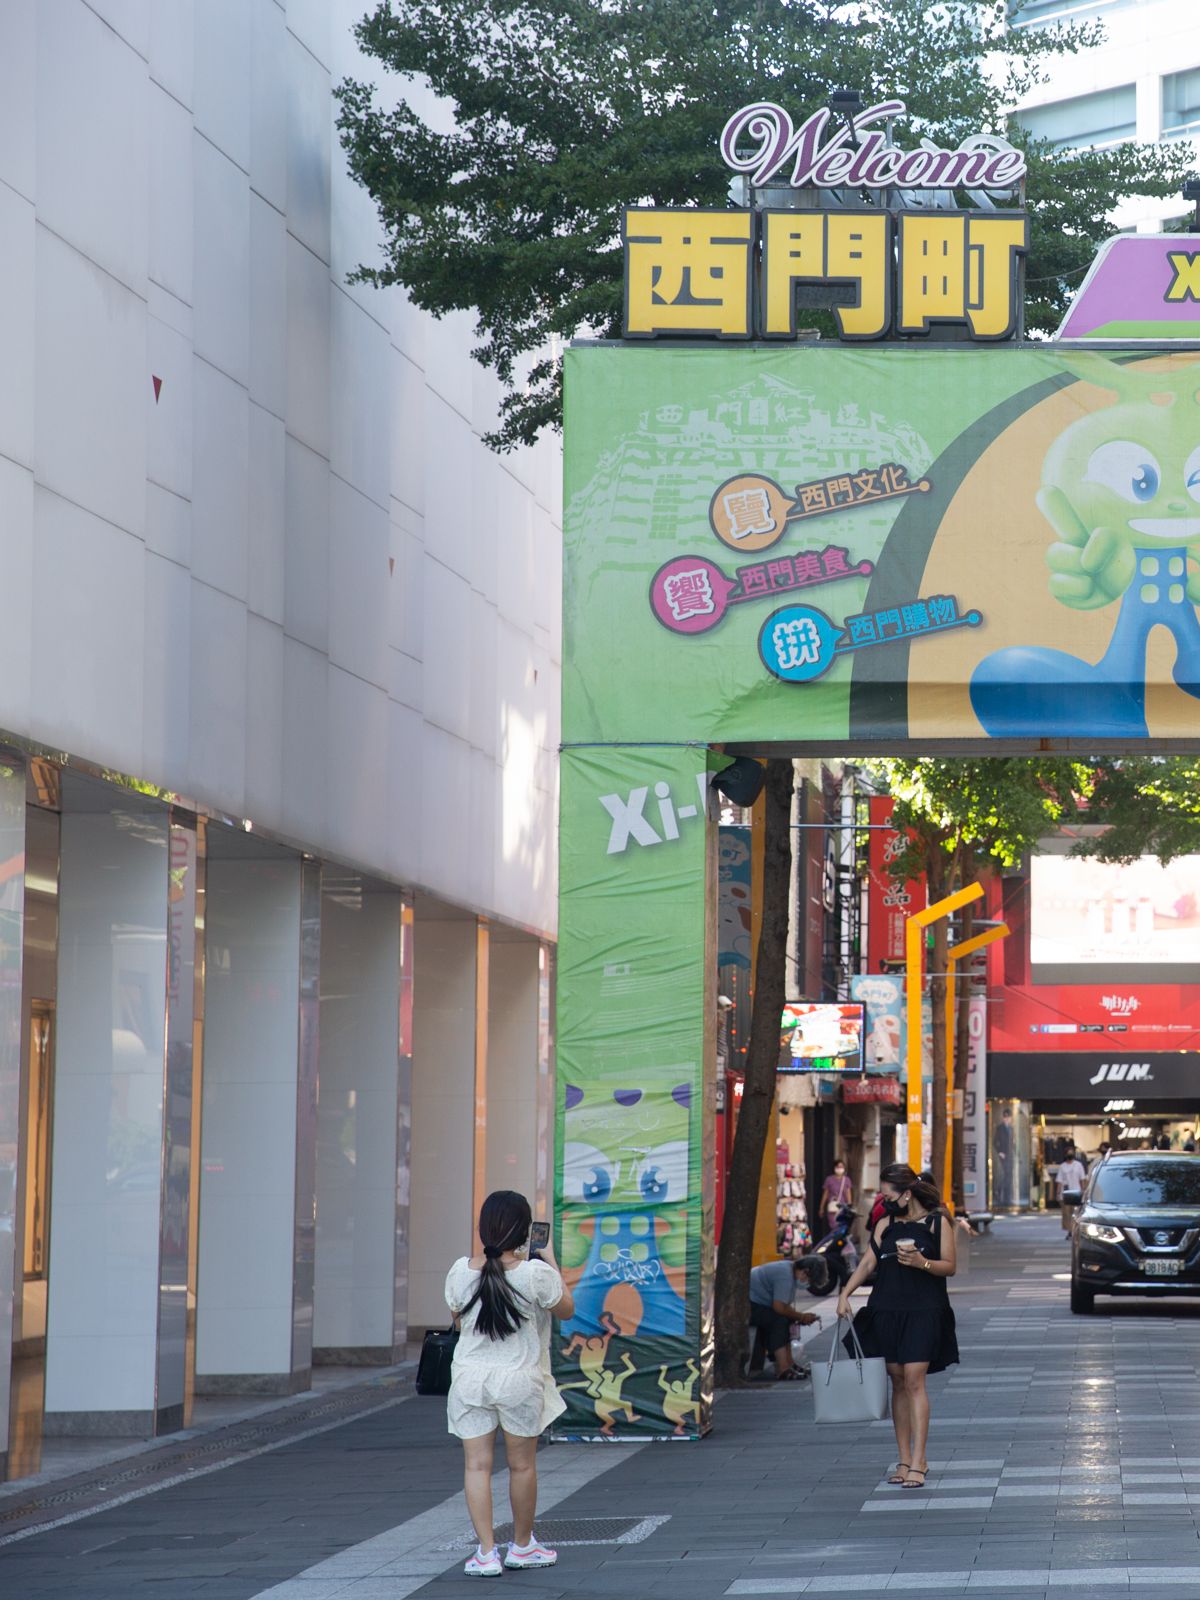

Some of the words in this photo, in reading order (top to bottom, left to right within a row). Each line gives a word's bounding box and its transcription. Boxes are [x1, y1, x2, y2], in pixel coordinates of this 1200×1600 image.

[720, 100, 1027, 188] Welcome
[623, 208, 1030, 340] 西門町
[799, 466, 909, 513] 西門文化
[739, 546, 849, 596] 西門美食
[773, 618, 822, 670] 拼
[847, 597, 957, 645] 西門購物
[598, 772, 706, 855] Xi-
[1089, 1063, 1151, 1086] JUN
[1103, 1099, 1135, 1113] JUN
[1117, 1127, 1152, 1141] JUN
